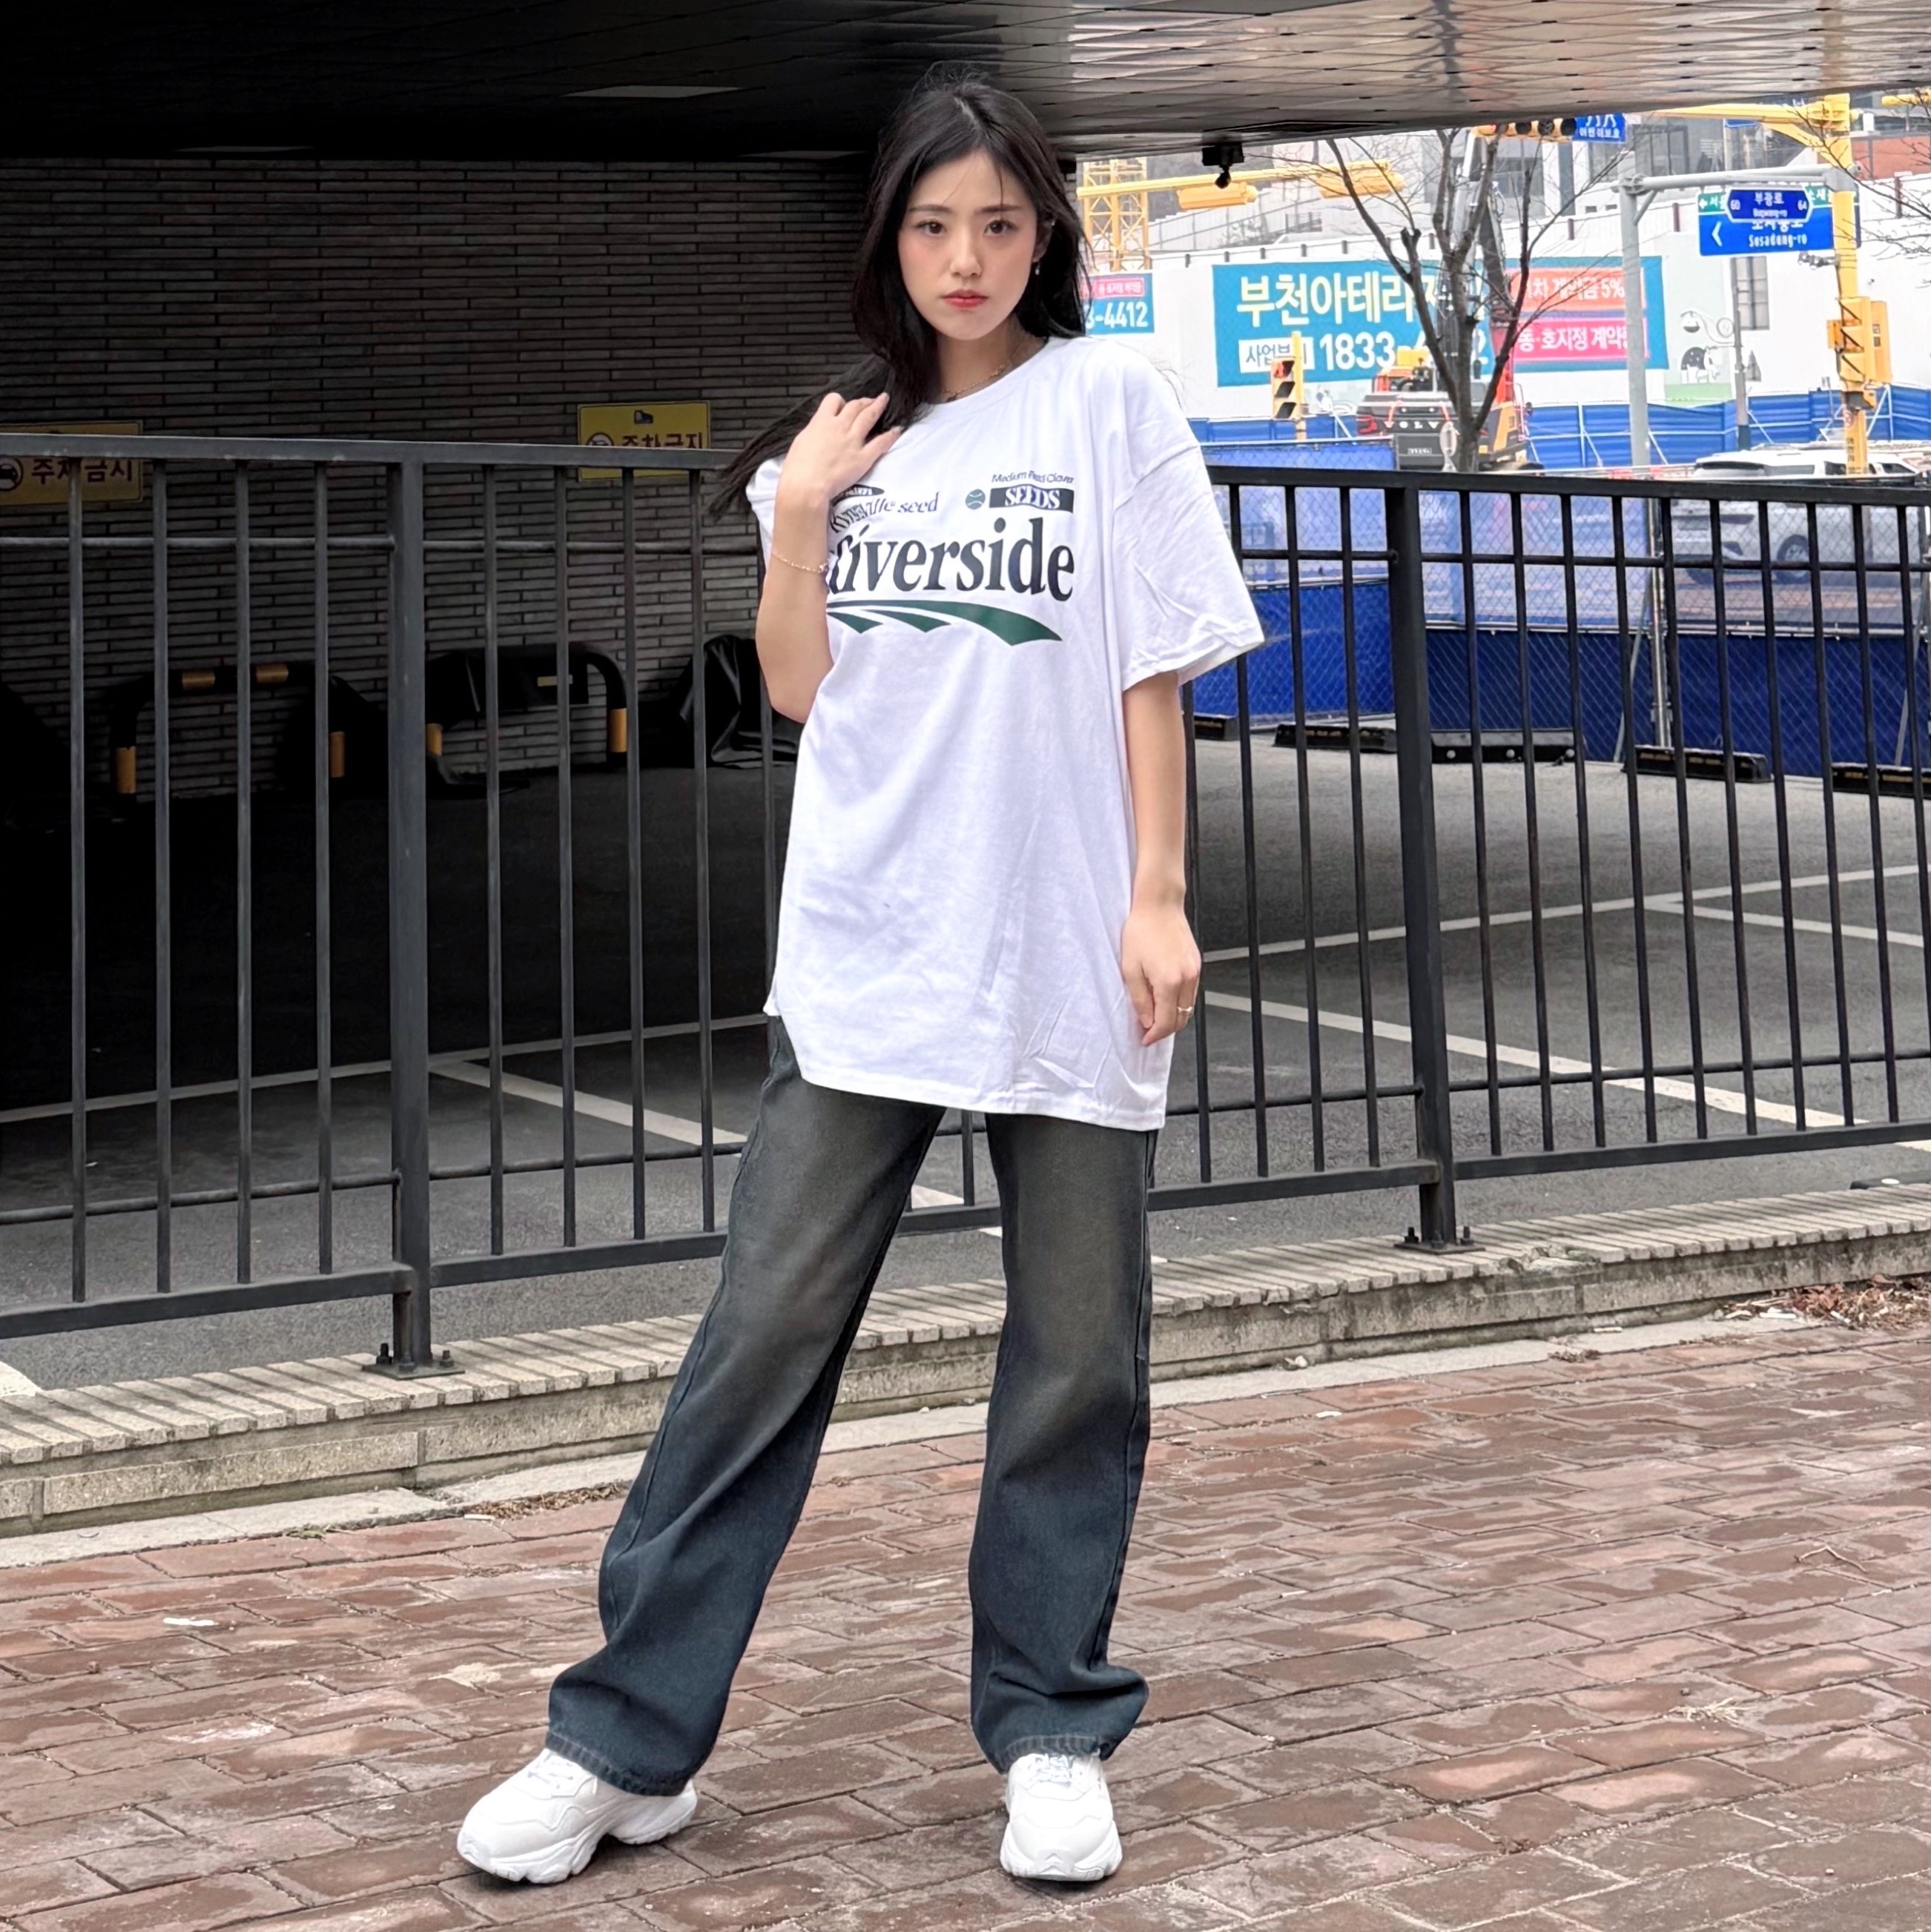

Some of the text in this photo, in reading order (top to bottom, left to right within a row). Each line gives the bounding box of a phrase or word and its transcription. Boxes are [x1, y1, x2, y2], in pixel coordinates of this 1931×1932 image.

[1384, 421, 1440, 429] VOLV
[897, 492, 940, 513] seed
[1005, 486, 1060, 509] SEEDS
